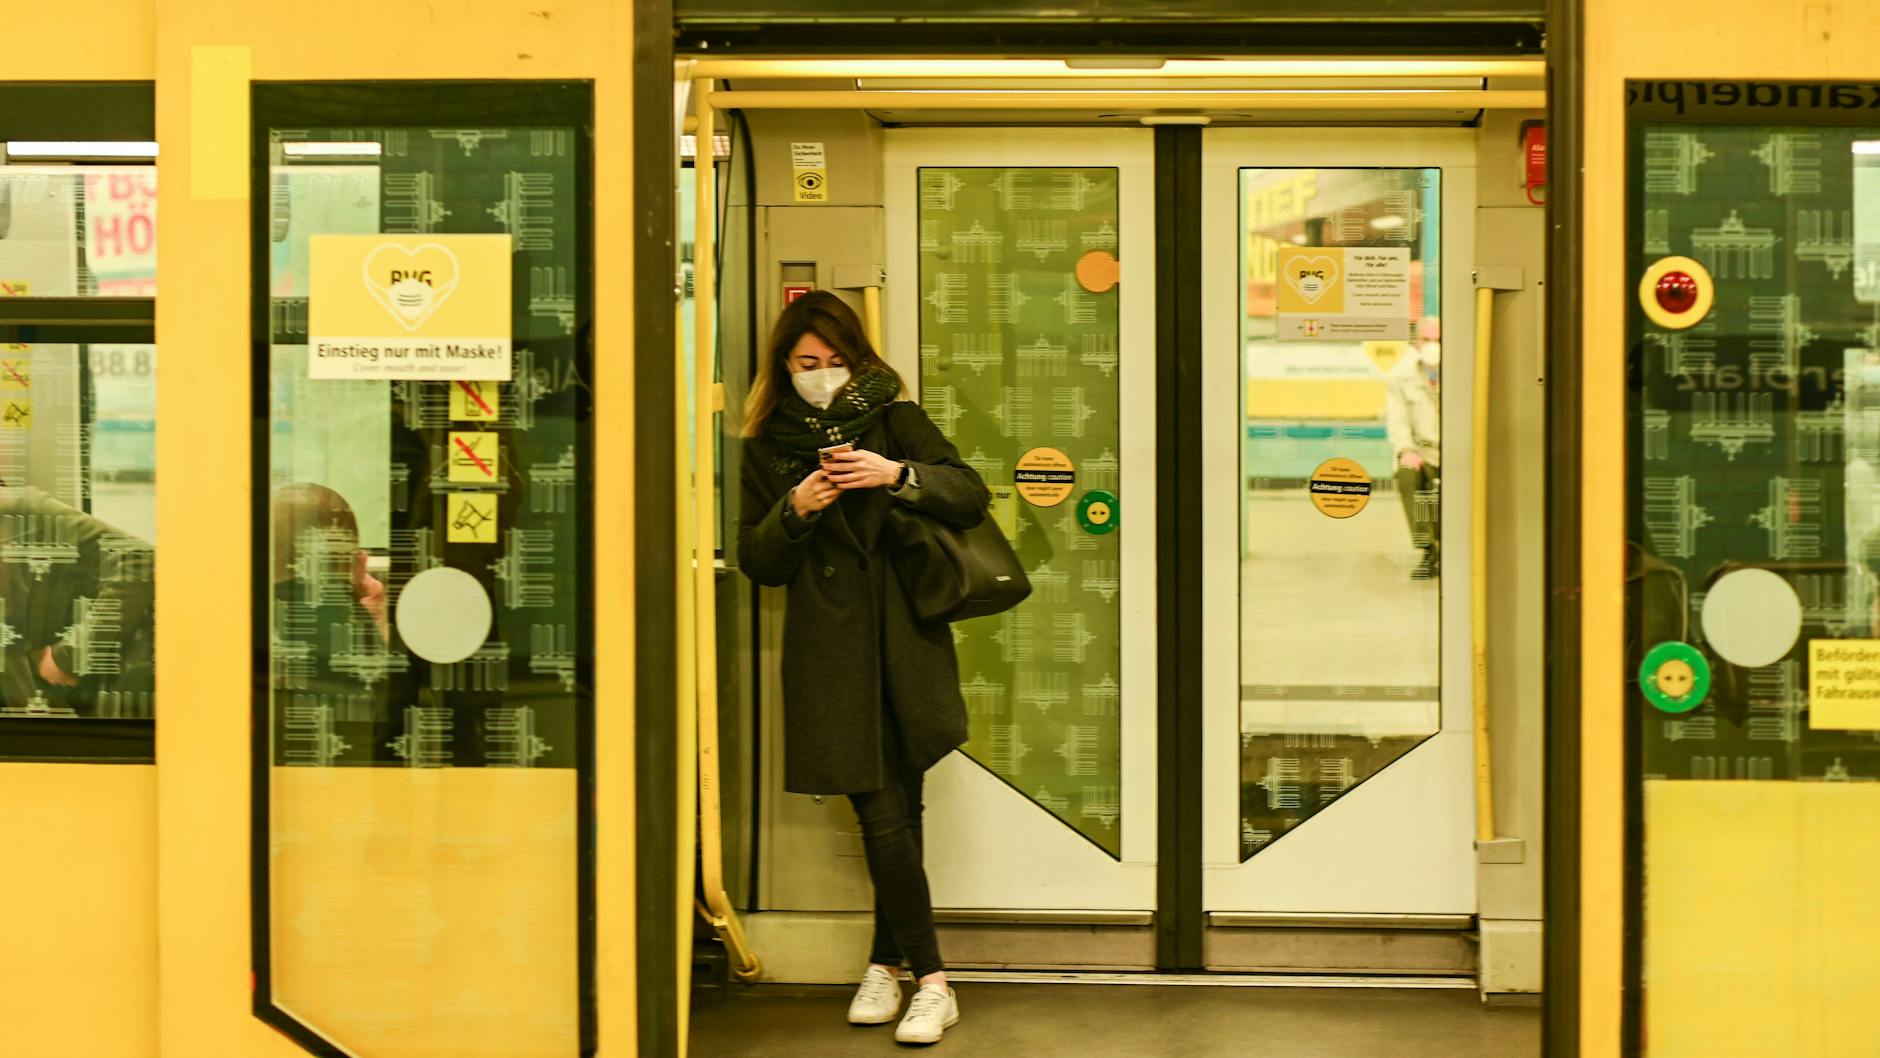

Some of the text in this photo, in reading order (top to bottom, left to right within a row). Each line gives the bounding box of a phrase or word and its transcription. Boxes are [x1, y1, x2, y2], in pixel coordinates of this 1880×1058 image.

[800, 192, 823, 200] Video
[317, 343, 502, 362] Einstieg nur mit Maske!
[353, 363, 381, 373] Cover
[418, 363, 436, 373] and
[1016, 472, 1047, 481] Achtung
[1311, 483, 1343, 493] Achtung
[1817, 667, 1839, 680] mit
